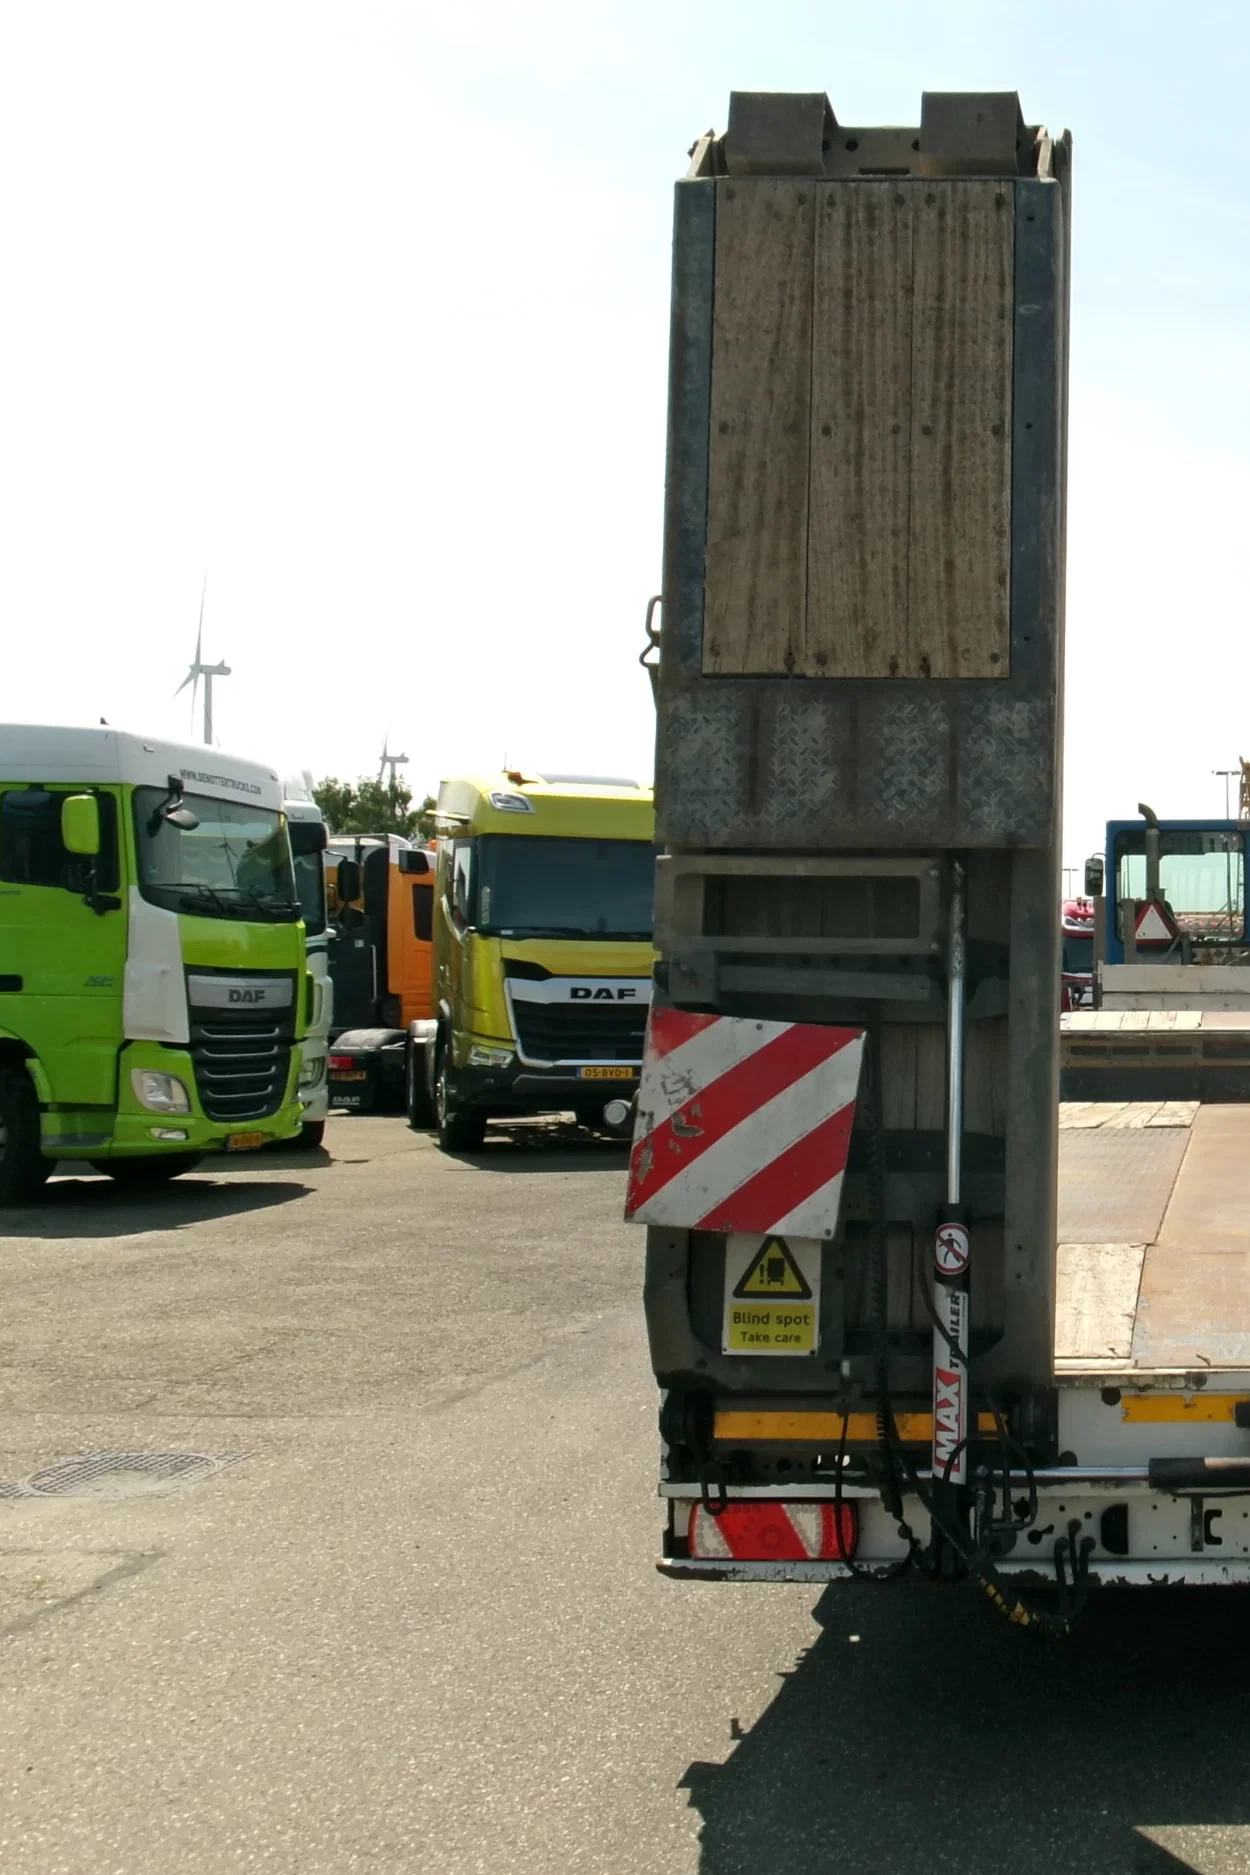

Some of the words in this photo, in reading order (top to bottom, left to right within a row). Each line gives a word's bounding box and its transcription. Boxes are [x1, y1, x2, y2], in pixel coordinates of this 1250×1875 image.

[228, 989, 266, 1003] DAF
[570, 987, 636, 1000] DAF
[733, 1312, 770, 1325] Blind
[775, 1314, 811, 1328] spot
[741, 1331, 770, 1343] Take
[774, 1333, 802, 1343] care
[936, 1377, 961, 1466] MAX
